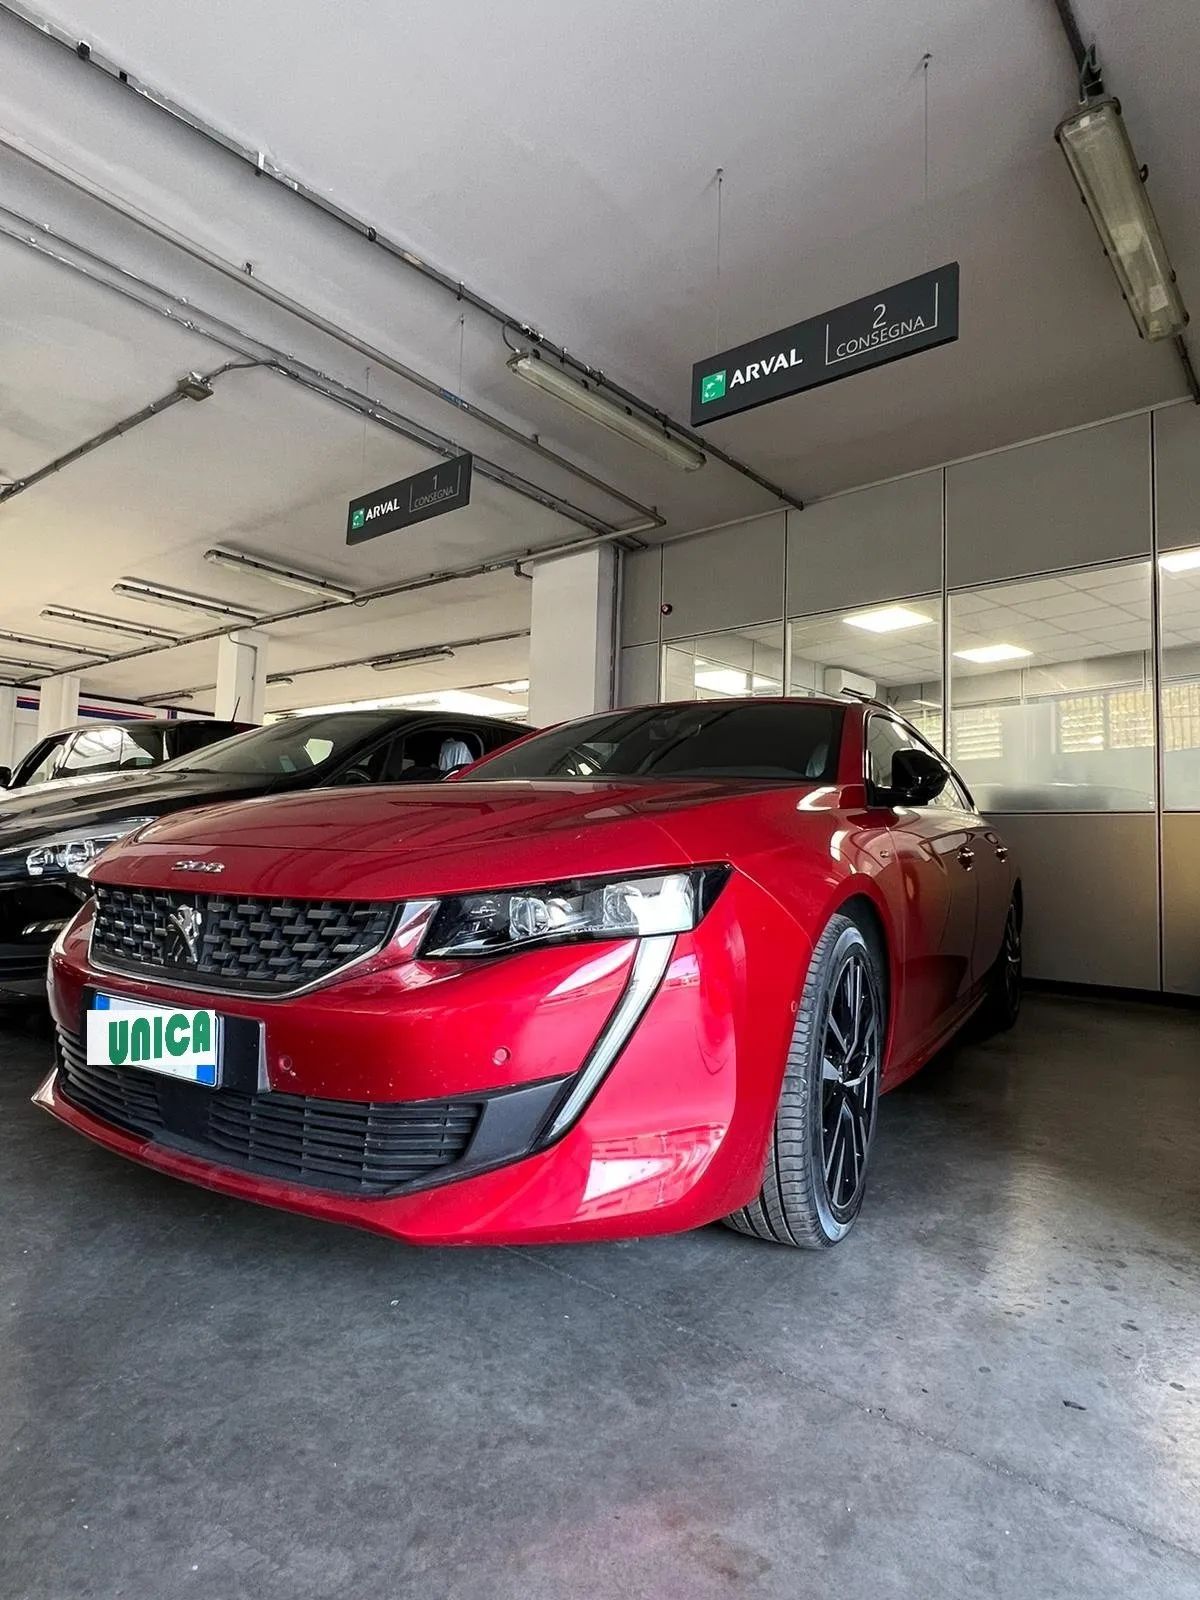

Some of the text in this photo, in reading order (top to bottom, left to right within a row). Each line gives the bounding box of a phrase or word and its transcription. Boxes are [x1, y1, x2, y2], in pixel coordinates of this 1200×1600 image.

[872, 303, 887, 329] 2
[836, 315, 925, 357] CONSEGNA
[729, 348, 803, 388] ARVAL
[432, 474, 438, 491] 1
[414, 485, 454, 508] CONSEGNA
[365, 498, 400, 521] ARVAL
